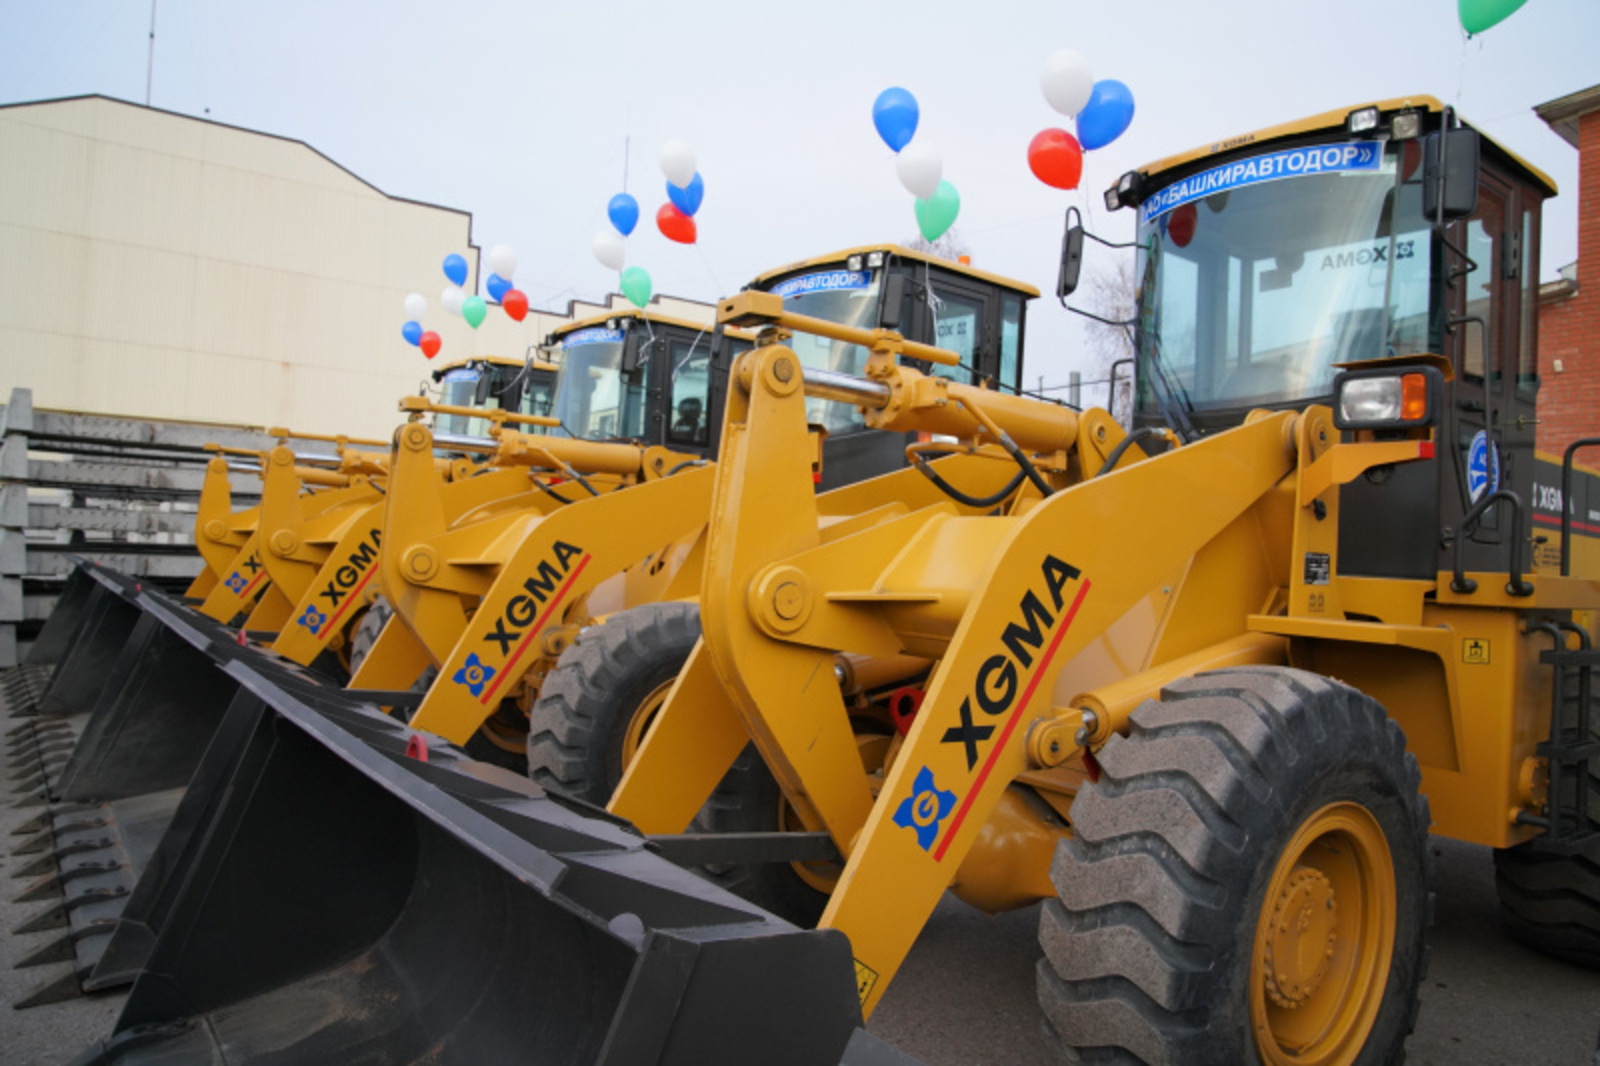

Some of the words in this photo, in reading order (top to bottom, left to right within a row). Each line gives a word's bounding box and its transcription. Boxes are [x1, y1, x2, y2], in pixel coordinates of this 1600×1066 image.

[319, 528, 382, 608] XGMA
[483, 540, 583, 657] XGMA
[940, 554, 1082, 773] XGMA
